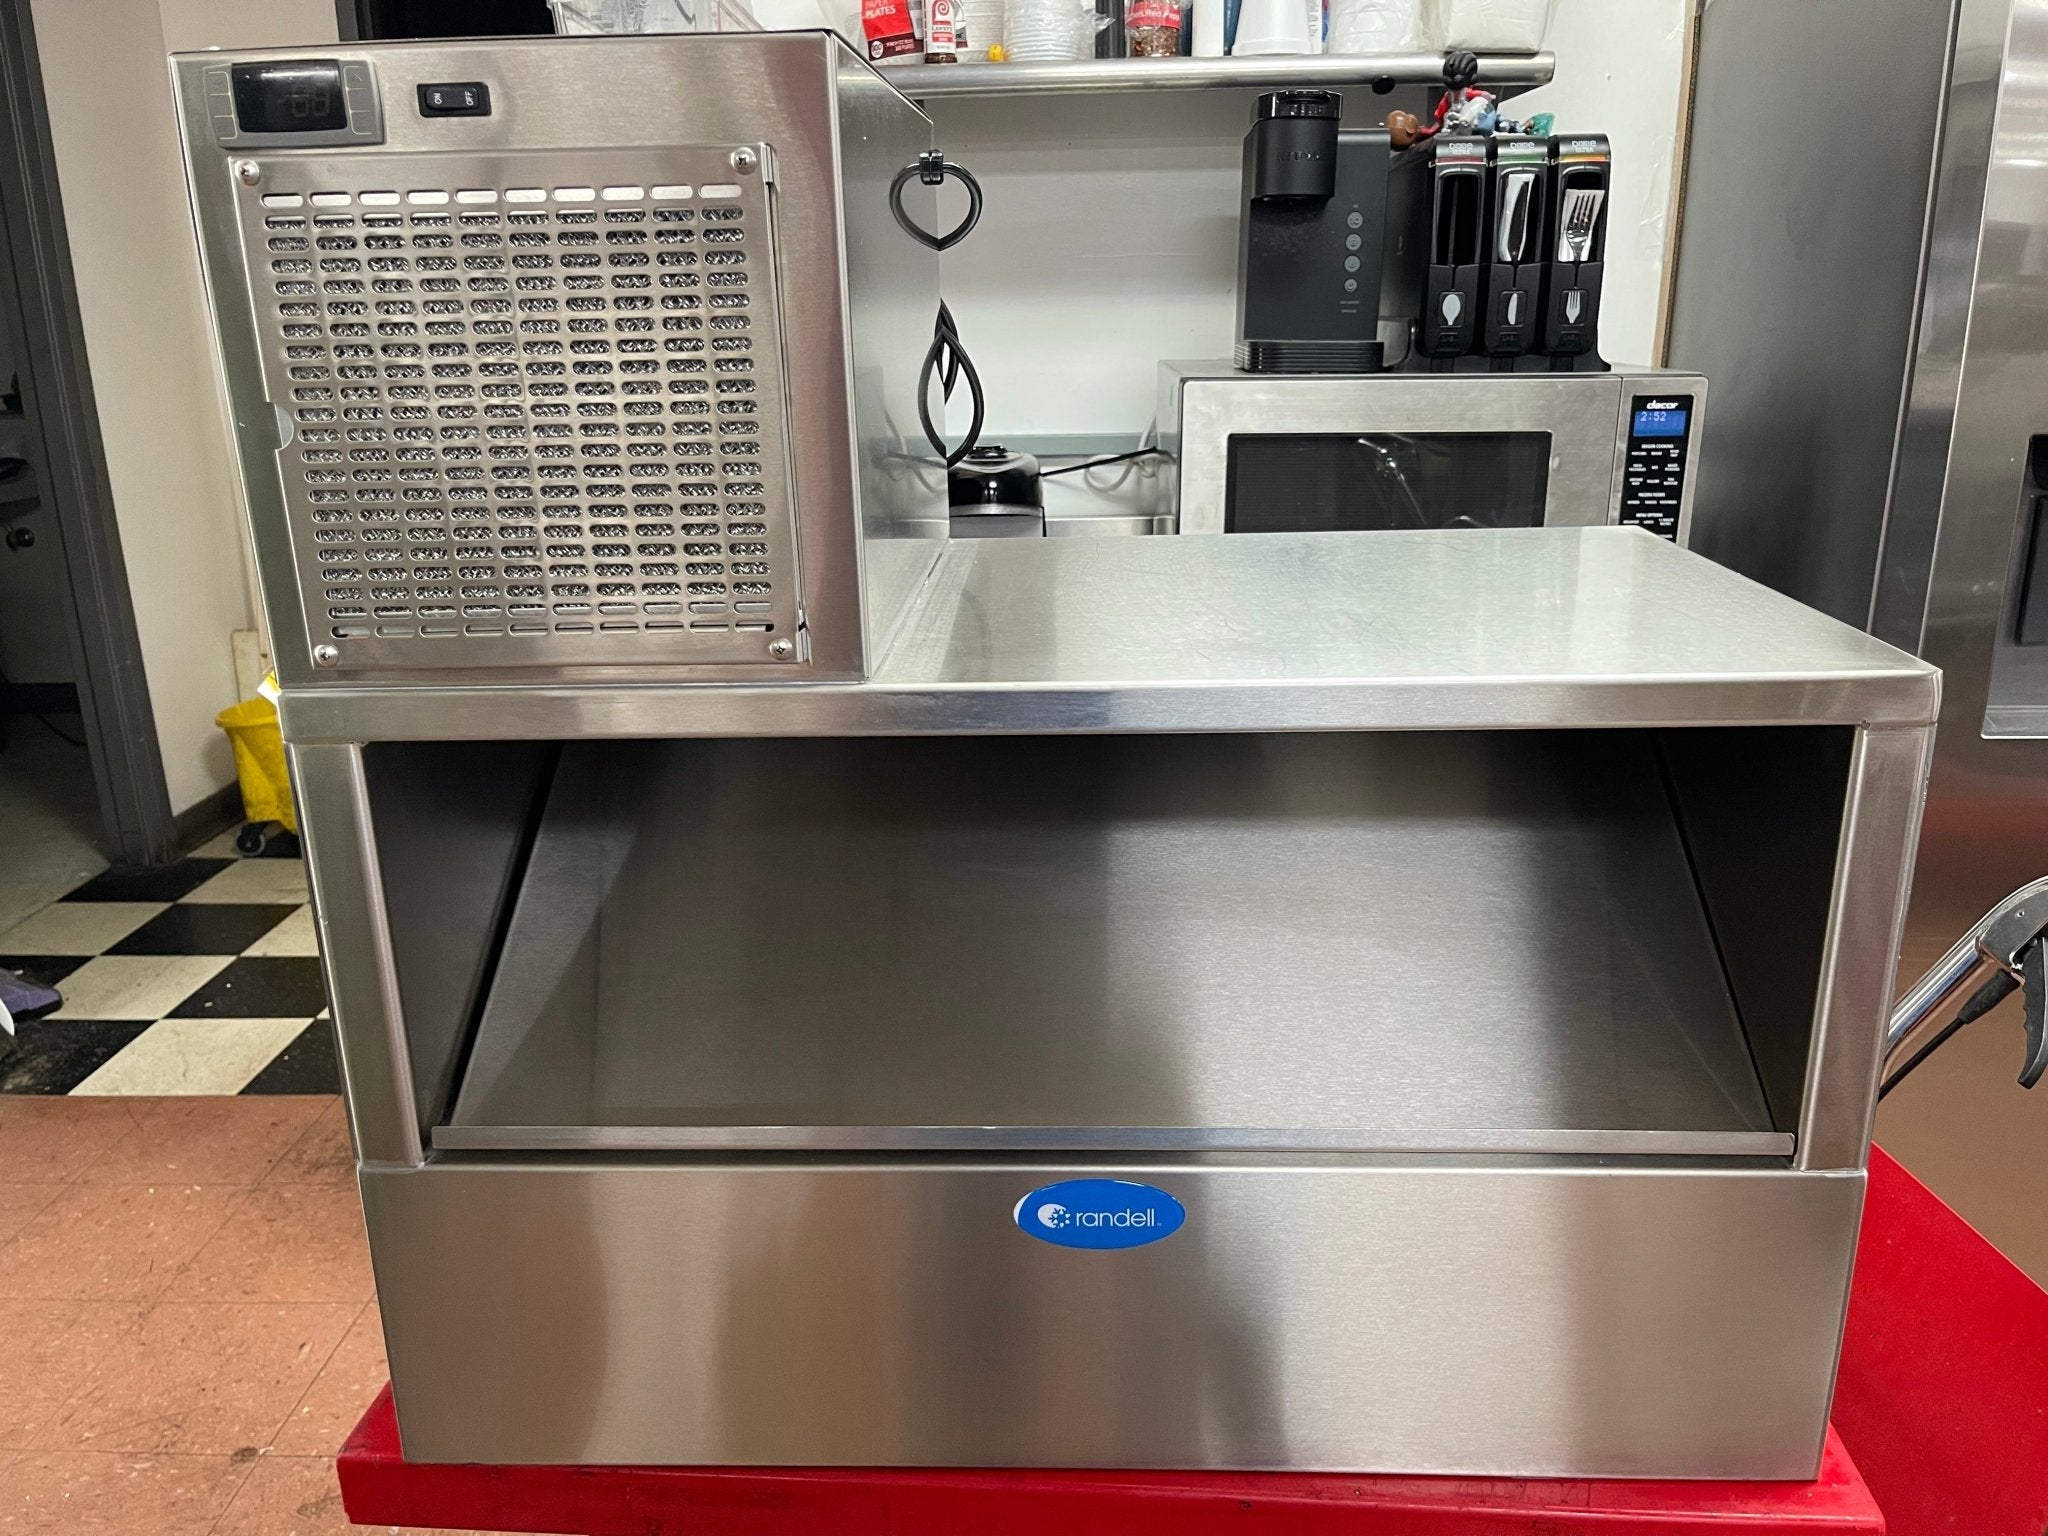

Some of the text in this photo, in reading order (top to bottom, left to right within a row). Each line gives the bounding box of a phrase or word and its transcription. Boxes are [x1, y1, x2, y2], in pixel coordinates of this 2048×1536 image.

[865, 5, 896, 18] PLATES
[1145, 9, 1161, 17] Red
[433, 92, 443, 105] ON
[464, 90, 474, 106] OFF
[1646, 399, 1679, 410] dacor
[1640, 411, 1667, 422] 2:52
[1076, 1208, 1155, 1227] randell
